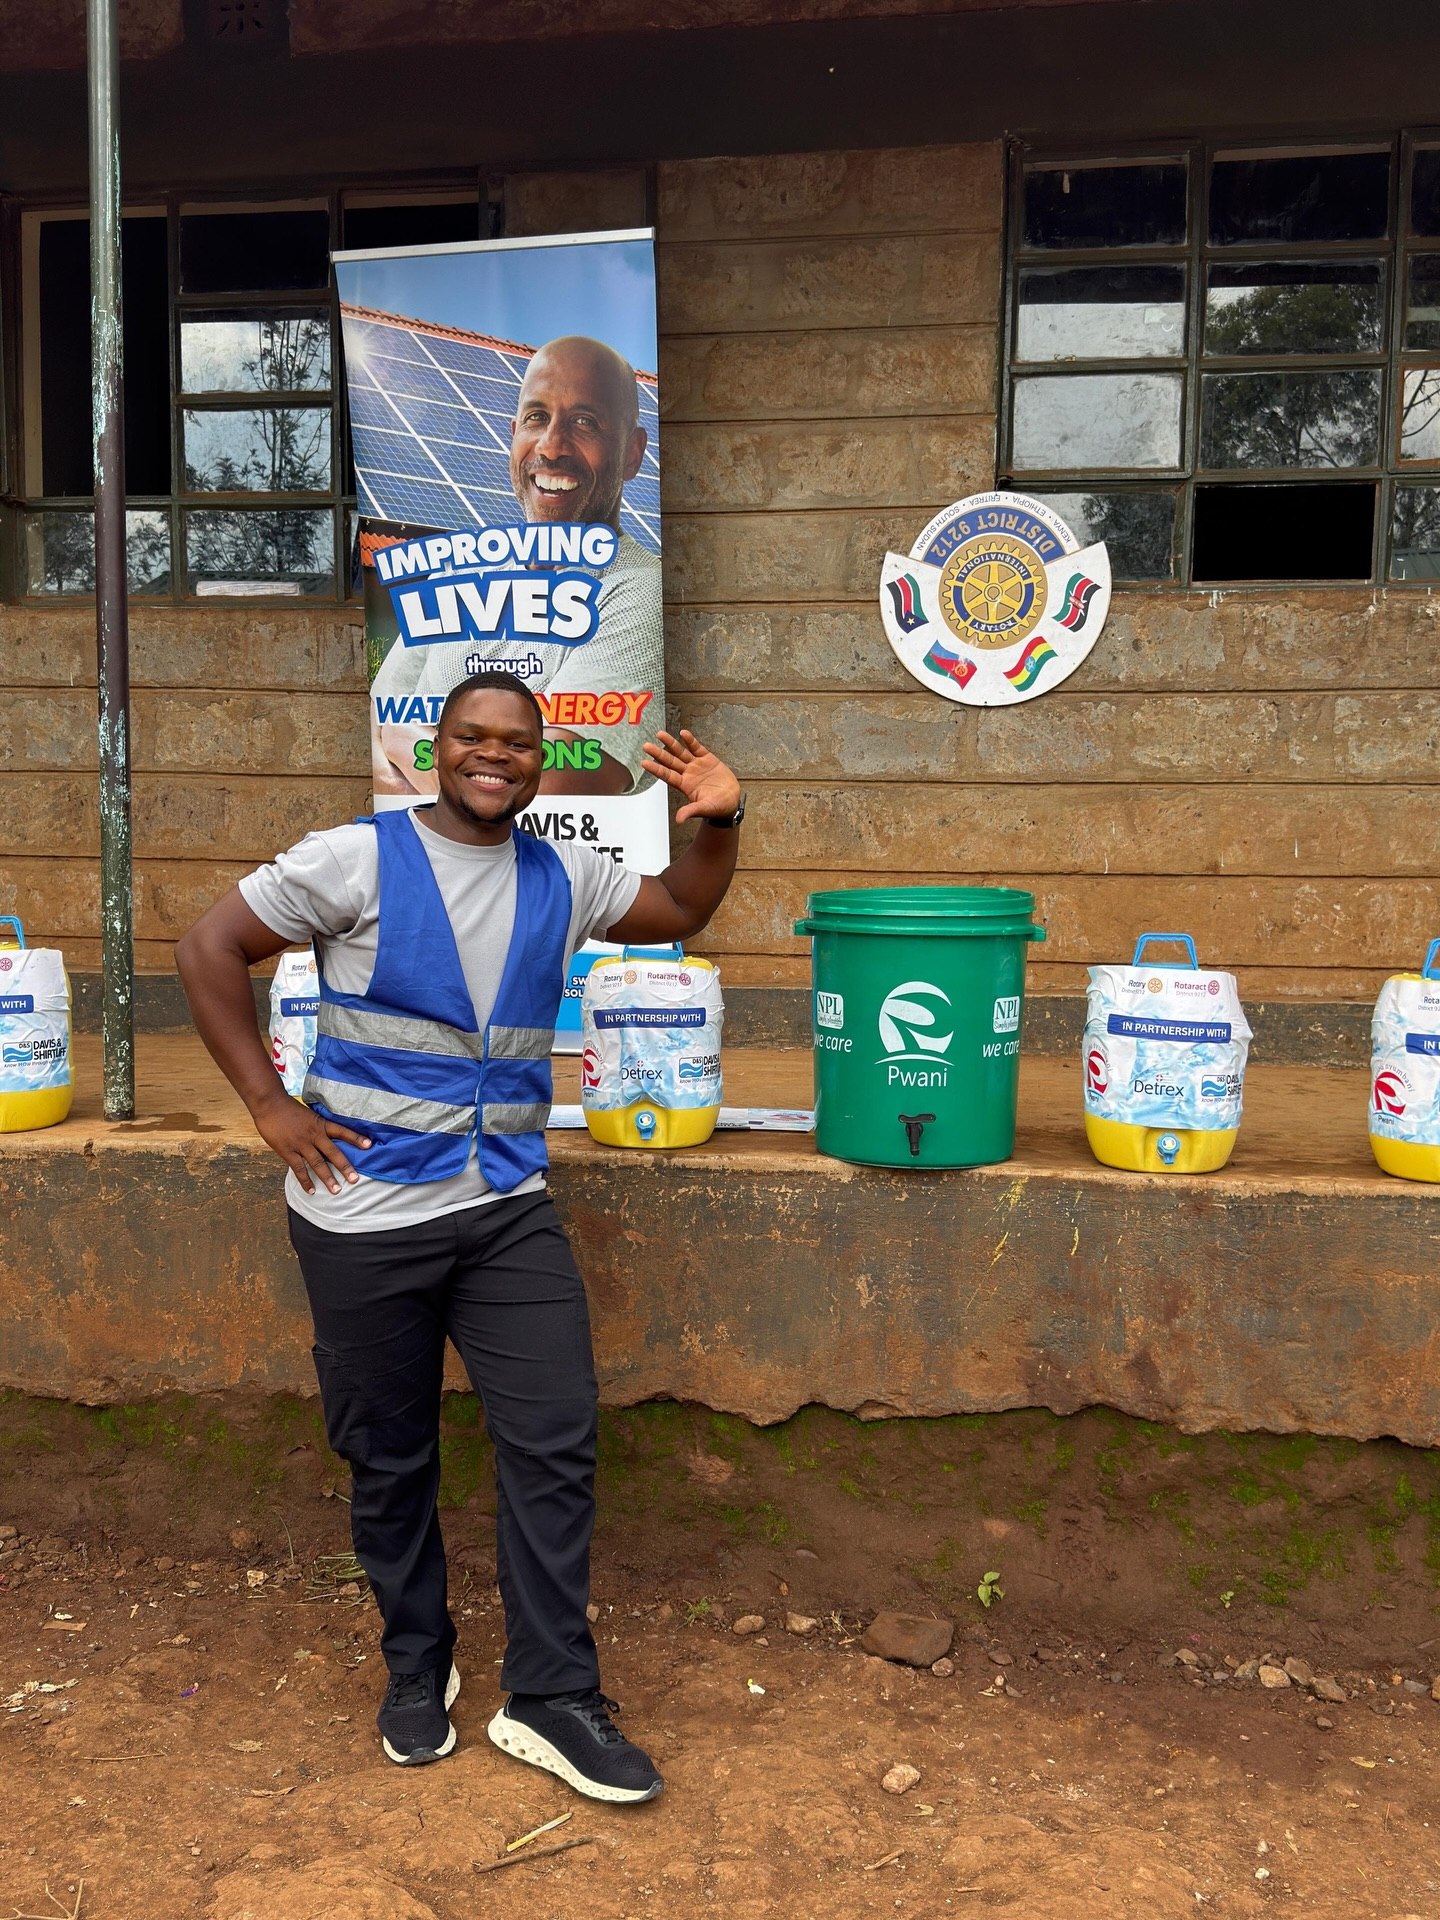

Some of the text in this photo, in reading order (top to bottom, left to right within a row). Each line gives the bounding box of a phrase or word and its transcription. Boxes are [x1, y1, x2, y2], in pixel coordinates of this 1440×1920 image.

[917, 494, 1072, 551] KENYA ETHIOPIA ERITREA SOUTH SUDAN
[931, 511, 1055, 558] DISTRICT 9212
[375, 526, 615, 581] IMPROVING
[958, 552, 1028, 579] INTERNATIONAL
[399, 579, 592, 639] LIVES
[972, 617, 1015, 632] ROTARY
[466, 653, 543, 679] through
[375, 691, 653, 726] WAT NERGY
[516, 812, 600, 842] AVIS &
[603, 974, 623, 983] Rotary
[647, 972, 678, 981] Rotaract
[1128, 979, 1146, 989] Rotary
[1174, 981, 1206, 991] Rotaract
[1, 1000, 27, 1009] WITH
[291, 1003, 299, 1011] IN
[817, 994, 842, 1016] NPL
[1423, 996, 1440, 1004] Rota
[604, 1013, 701, 1023] IN PARTNERSHIP WITH
[1122, 1021, 1227, 1038] IN PARTNERSHIP WITH
[33, 1039, 56, 1051] DAVIS
[56, 1038, 62, 1048] &
[825, 1036, 853, 1053] care
[982, 1042, 1002, 1058] we
[1424, 1040, 1436, 1051] IN
[33, 1047, 67, 1061] SHIRTLIFF
[621, 1067, 663, 1081] Detrex
[887, 1065, 948, 1088] Pwani
[1134, 1080, 1184, 1097] Detrex
[1377, 1115, 1395, 1125] Pwani
